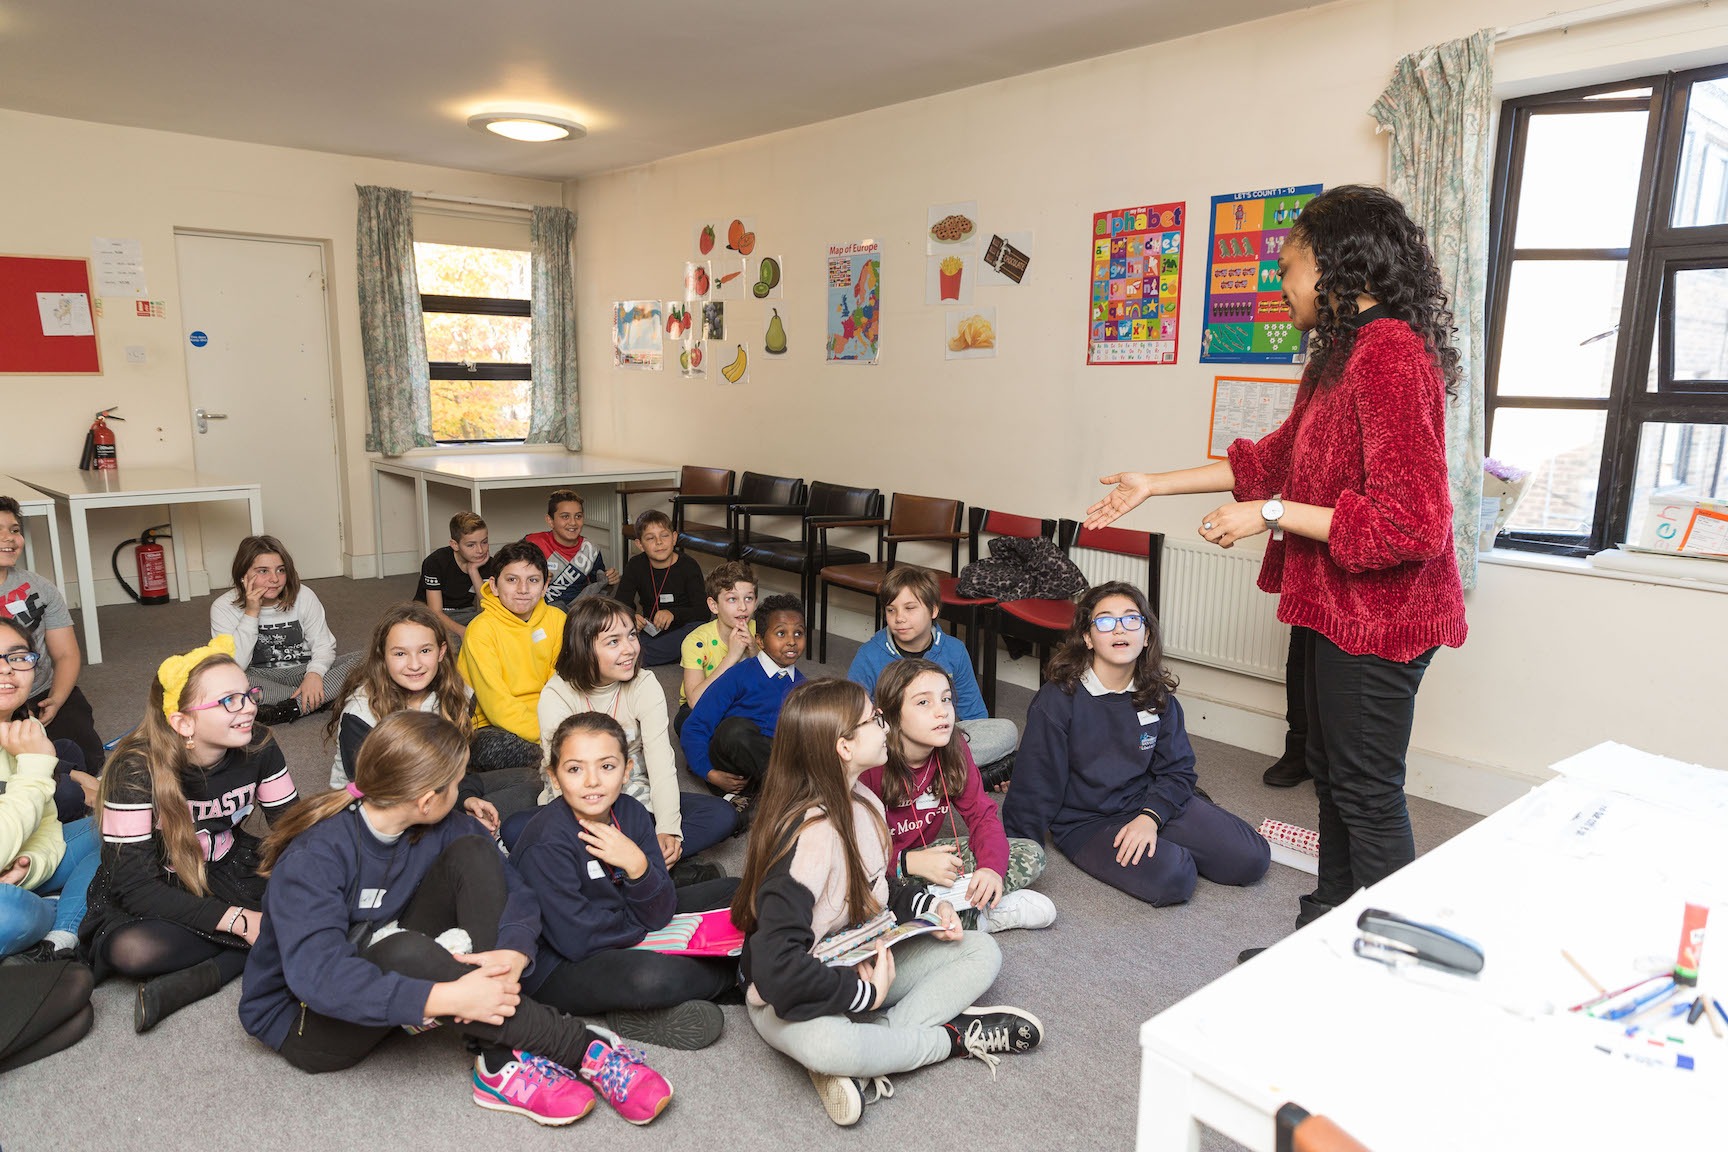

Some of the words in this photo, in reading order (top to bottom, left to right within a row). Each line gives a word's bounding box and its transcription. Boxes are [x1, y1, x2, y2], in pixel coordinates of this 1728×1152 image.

[1234, 191, 1252, 200] LET'S
[1252, 189, 1276, 198] COUNT
[1096, 206, 1182, 237] alphabet
[829, 245, 843, 256] Map
[844, 244, 852, 253] of
[853, 242, 878, 253] Europe
[574, 540, 598, 575] 92
[504, 1077, 539, 1105] N
